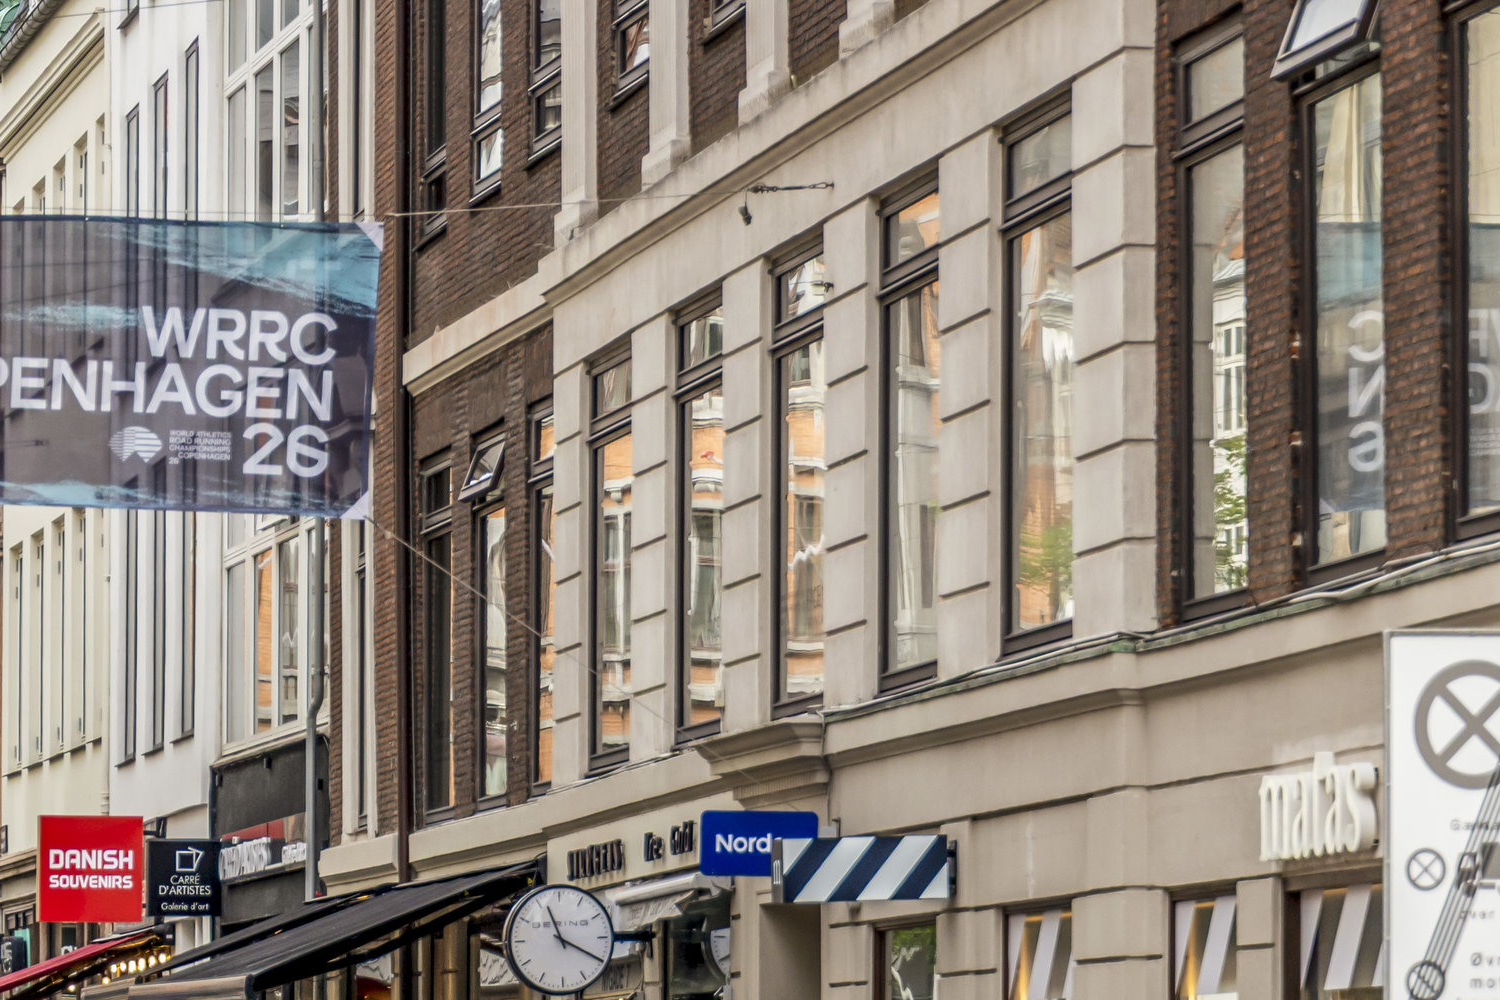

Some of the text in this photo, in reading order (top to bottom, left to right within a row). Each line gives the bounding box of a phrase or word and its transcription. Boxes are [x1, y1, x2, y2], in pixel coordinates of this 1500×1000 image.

[141, 305, 338, 366] WRRC
[195, 438, 232, 446] RUNNING
[168, 445, 231, 453] CHAMPIONSHIPS
[241, 422, 330, 479] 26
[177, 452, 231, 461] COPENHAGEN
[1260, 751, 1378, 862] matas
[715, 833, 772, 853] Nord
[49, 849, 134, 870] DANISH
[49, 875, 133, 889] SOUVENIRS
[170, 872, 200, 885] CARRÉ
[158, 885, 211, 896] D'ARTISTES
[161, 902, 210, 911] Galerie d'art
[531, 919, 589, 929] BERING
